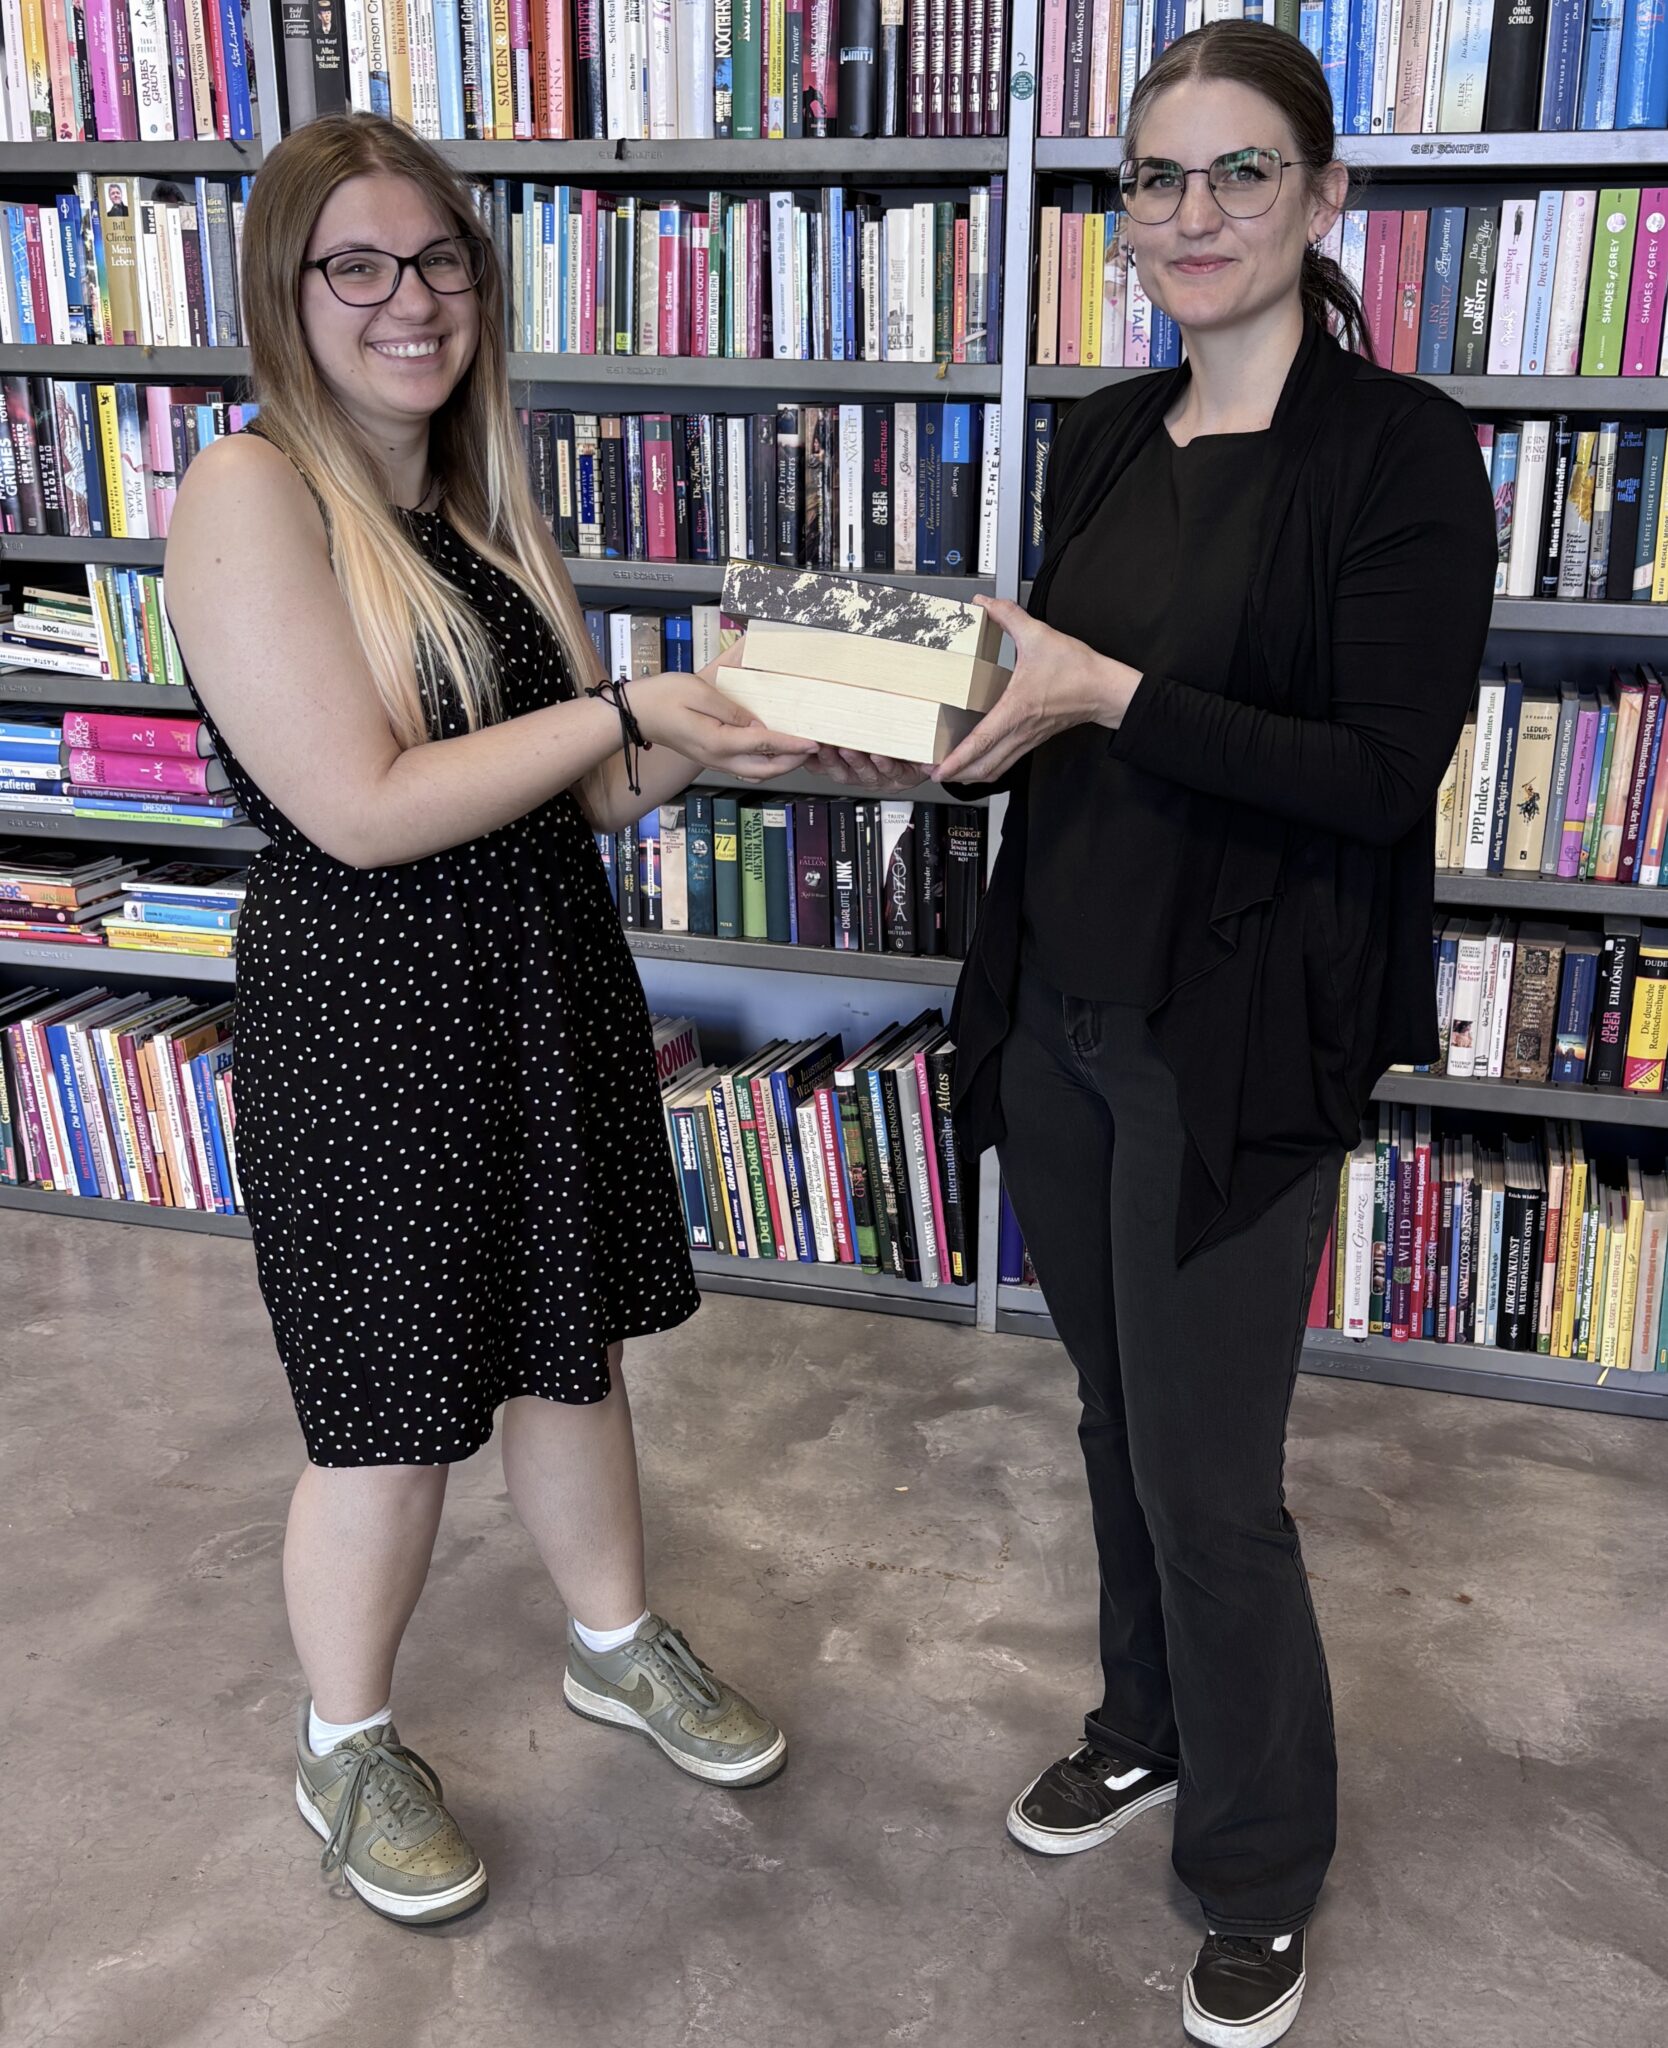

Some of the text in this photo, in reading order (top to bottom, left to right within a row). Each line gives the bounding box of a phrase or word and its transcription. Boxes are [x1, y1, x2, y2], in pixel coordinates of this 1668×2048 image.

[715, 0, 732, 58] SHELDON
[1508, 15, 1534, 25] SCHULD
[1512, 7, 1532, 16] OHNE
[321, 47, 335, 55] Alles
[1557, 12, 1570, 102] MAXIME FERRARI
[142, 59, 152, 107] GRABES
[914, 78, 920, 92] 1
[933, 78, 941, 92] 2
[952, 78, 959, 93] 3
[971, 78, 978, 93] 4
[990, 74, 997, 91] 5
[1401, 60, 1414, 106] Annette
[791, 94, 799, 124] MONIKA
[106, 232, 136, 242] Clinton
[111, 245, 132, 255] Mein
[112, 222, 126, 231] Bill
[869, 228, 877, 266] SÜDTIROL
[1536, 204, 1555, 288] Dreck am Stecken
[63, 225, 77, 279] Argentinien
[111, 257, 135, 267] Leben
[1469, 243, 1478, 260] Das
[1504, 248, 1517, 300] Bagshawe
[20, 274, 32, 324] Kat Martin
[665, 271, 673, 311] Schweiz
[1601, 239, 1620, 324] SHADES of GREY
[1640, 239, 1659, 324] SHADES of GREY
[709, 276, 717, 347] RICHTIG WANDERN
[1131, 283, 1145, 344] EX TALK
[1429, 302, 1440, 323] INY
[1463, 296, 1475, 318] INY
[1472, 278, 1488, 335] LORENTZ
[690, 445, 701, 499] Die Kapelle
[873, 458, 881, 473] DAS
[880, 420, 888, 487] ALPHABETHAUS
[1649, 455, 1658, 492] EMINENZ
[45, 445, 59, 510] DIE TOTEN
[777, 460, 786, 505] Die Frau
[787, 456, 796, 512] des Ketzers
[872, 491, 880, 525] ADLER
[880, 490, 888, 526] OLSEN
[1549, 457, 1567, 558] Nieten in Nadelstreifen
[1646, 493, 1654, 521] SEINER
[1644, 523, 1652, 542] ENTE
[42, 625, 60, 634] DOGS
[132, 733, 143, 742] 2
[146, 730, 156, 748] L-Z
[1522, 733, 1552, 741] STRUMPF
[1526, 726, 1550, 734] LEDER-
[154, 761, 164, 783] A-K
[1556, 719, 1573, 796] PFERDEAUSBILDUNG
[1627, 695, 1659, 840] Die 100 berühmtesten Rezepte der Welt
[142, 803, 173, 813] DRESDEN
[715, 836, 732, 852] 77
[744, 820, 753, 873] LYRIK DES
[751, 812, 763, 883] ABENDLANDS
[947, 827, 982, 839] GEORGE
[836, 860, 853, 930] LINK CHARLOTTE
[1608, 946, 1626, 1006] ERLÖSUNG
[1600, 1012, 1611, 1044] ADLER
[1608, 1011, 1621, 1044] OLSEN
[1640, 983, 1655, 1035] Die deutsche
[1648, 984, 1666, 1050] Rechtschreibung
[60, 1053, 82, 1129] Die besten Rezepte
[916, 1063, 927, 1096] CANADA
[1639, 1069, 1659, 1088] NEU
[125, 1058, 153, 1174] Lieblingsrezepte der Landfrauen
[723, 1082, 744, 1169] Barock und Rokoko
[752, 1090, 770, 1160] ANDALUSIEN
[763, 1086, 780, 1157] Die Renaissance
[884, 1080, 906, 1194] ITALIENISCHE RENAISSANCE
[935, 1073, 958, 1205] Internationaler Atlas
[746, 1130, 771, 1244] Der Natur-Doktor
[818, 1092, 848, 1244] AUTO- UND REISEKARTE DEUTSCHLAND
[911, 1112, 936, 1259] FORMEL-1-JAHRBUCH 2003-04
[1398, 1164, 1413, 1262] WILD in der Küche
[1426, 1241, 1437, 1271] ROSEN
[1504, 1236, 1520, 1315] KIRCHENKUNST
[1518, 1209, 1535, 1315] IM EUROPÄISCHEN OSTEN
[1567, 1217, 1582, 1292] FREUDE AM GRILLEN
[1582, 1210, 1600, 1320] Aufläufe, Gratins und Soufflés
